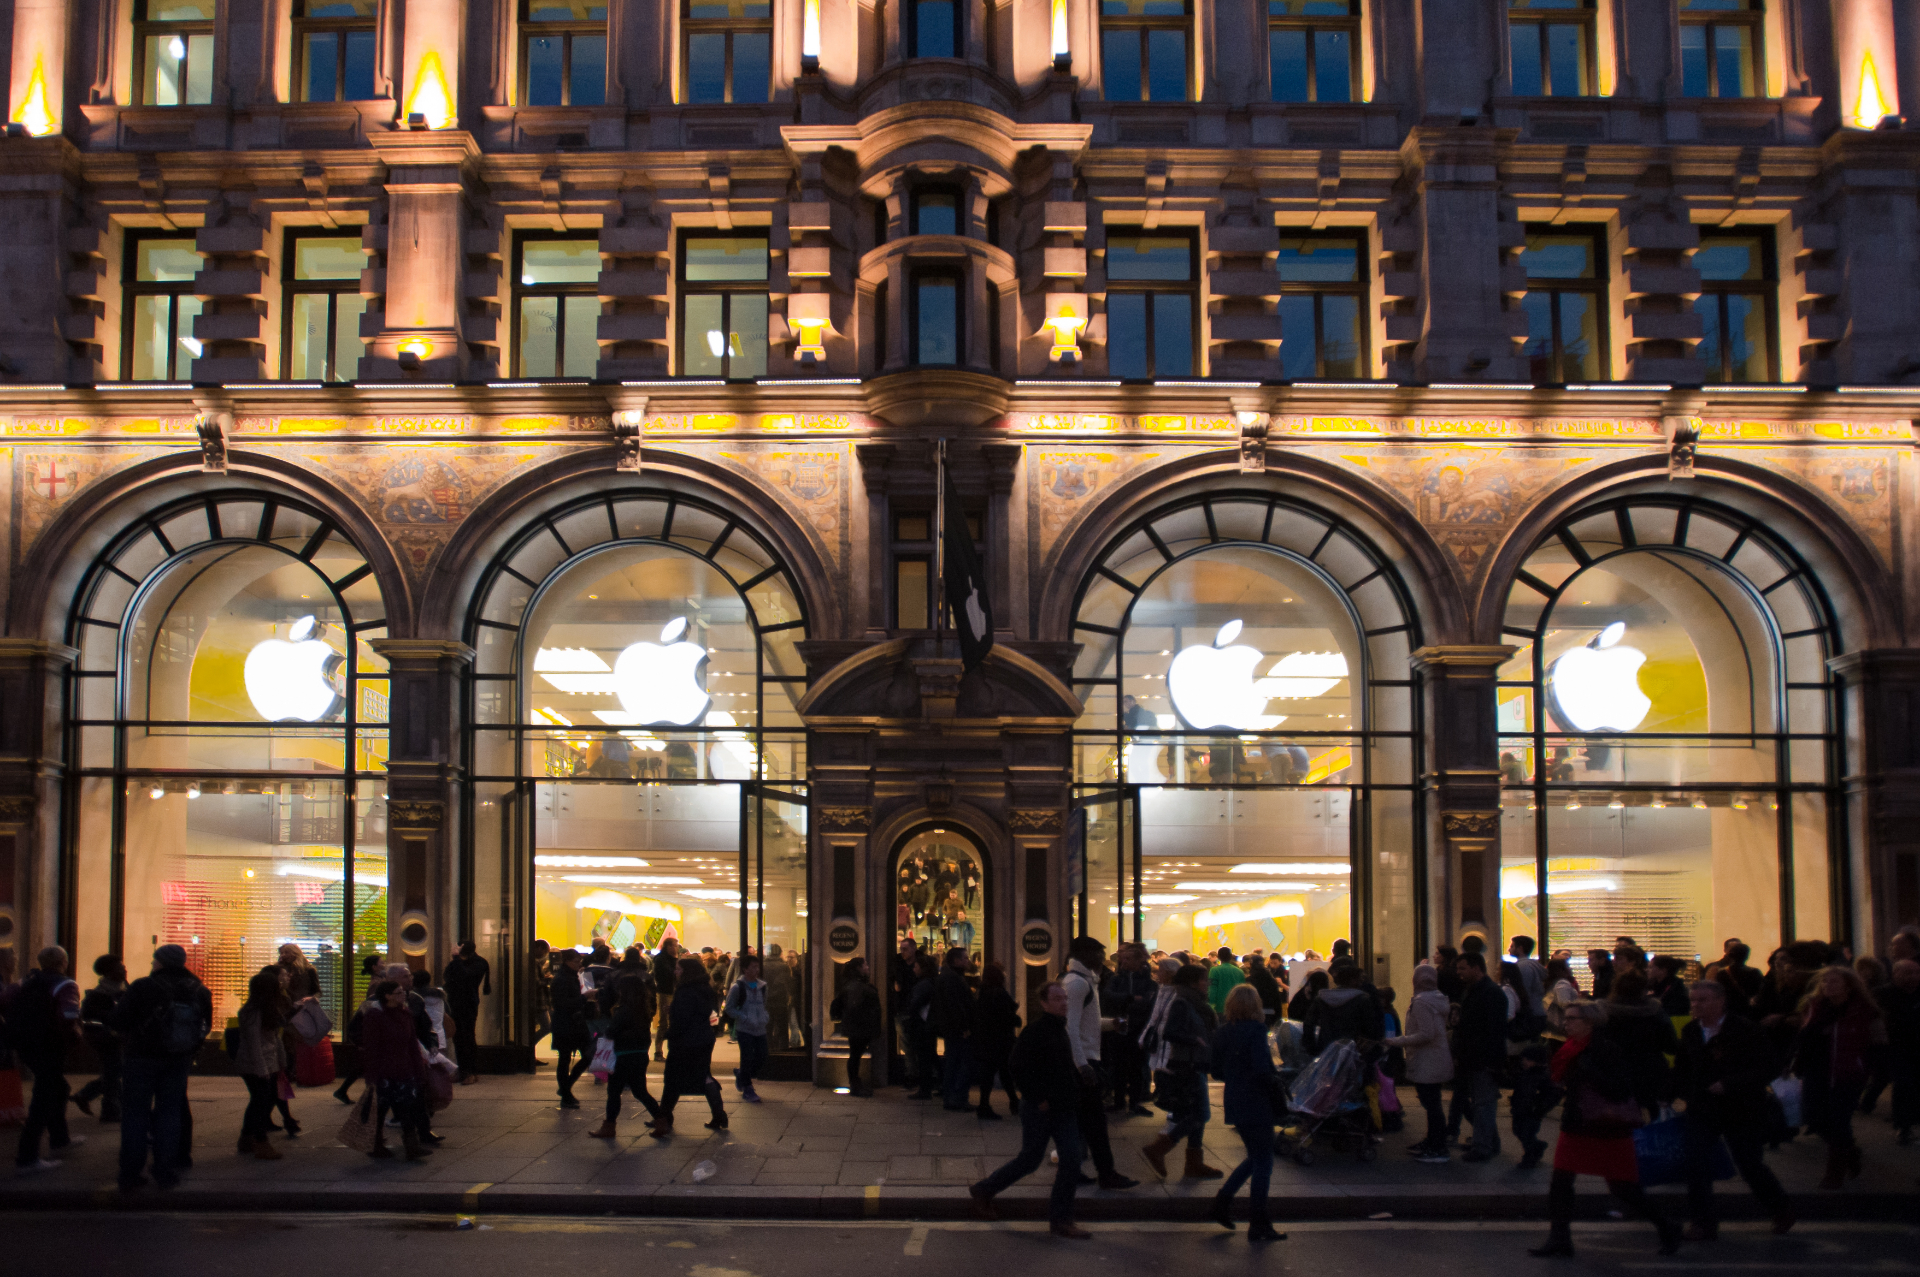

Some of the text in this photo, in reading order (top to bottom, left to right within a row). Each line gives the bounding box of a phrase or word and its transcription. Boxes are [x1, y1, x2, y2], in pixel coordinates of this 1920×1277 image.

[1110, 417, 1160, 429] PARIS
[1319, 418, 1409, 431] NEW YORK
[1768, 423, 1817, 434] BERLIN
[401, 468, 419, 479] VR
[197, 896, 243, 909] iPhone
